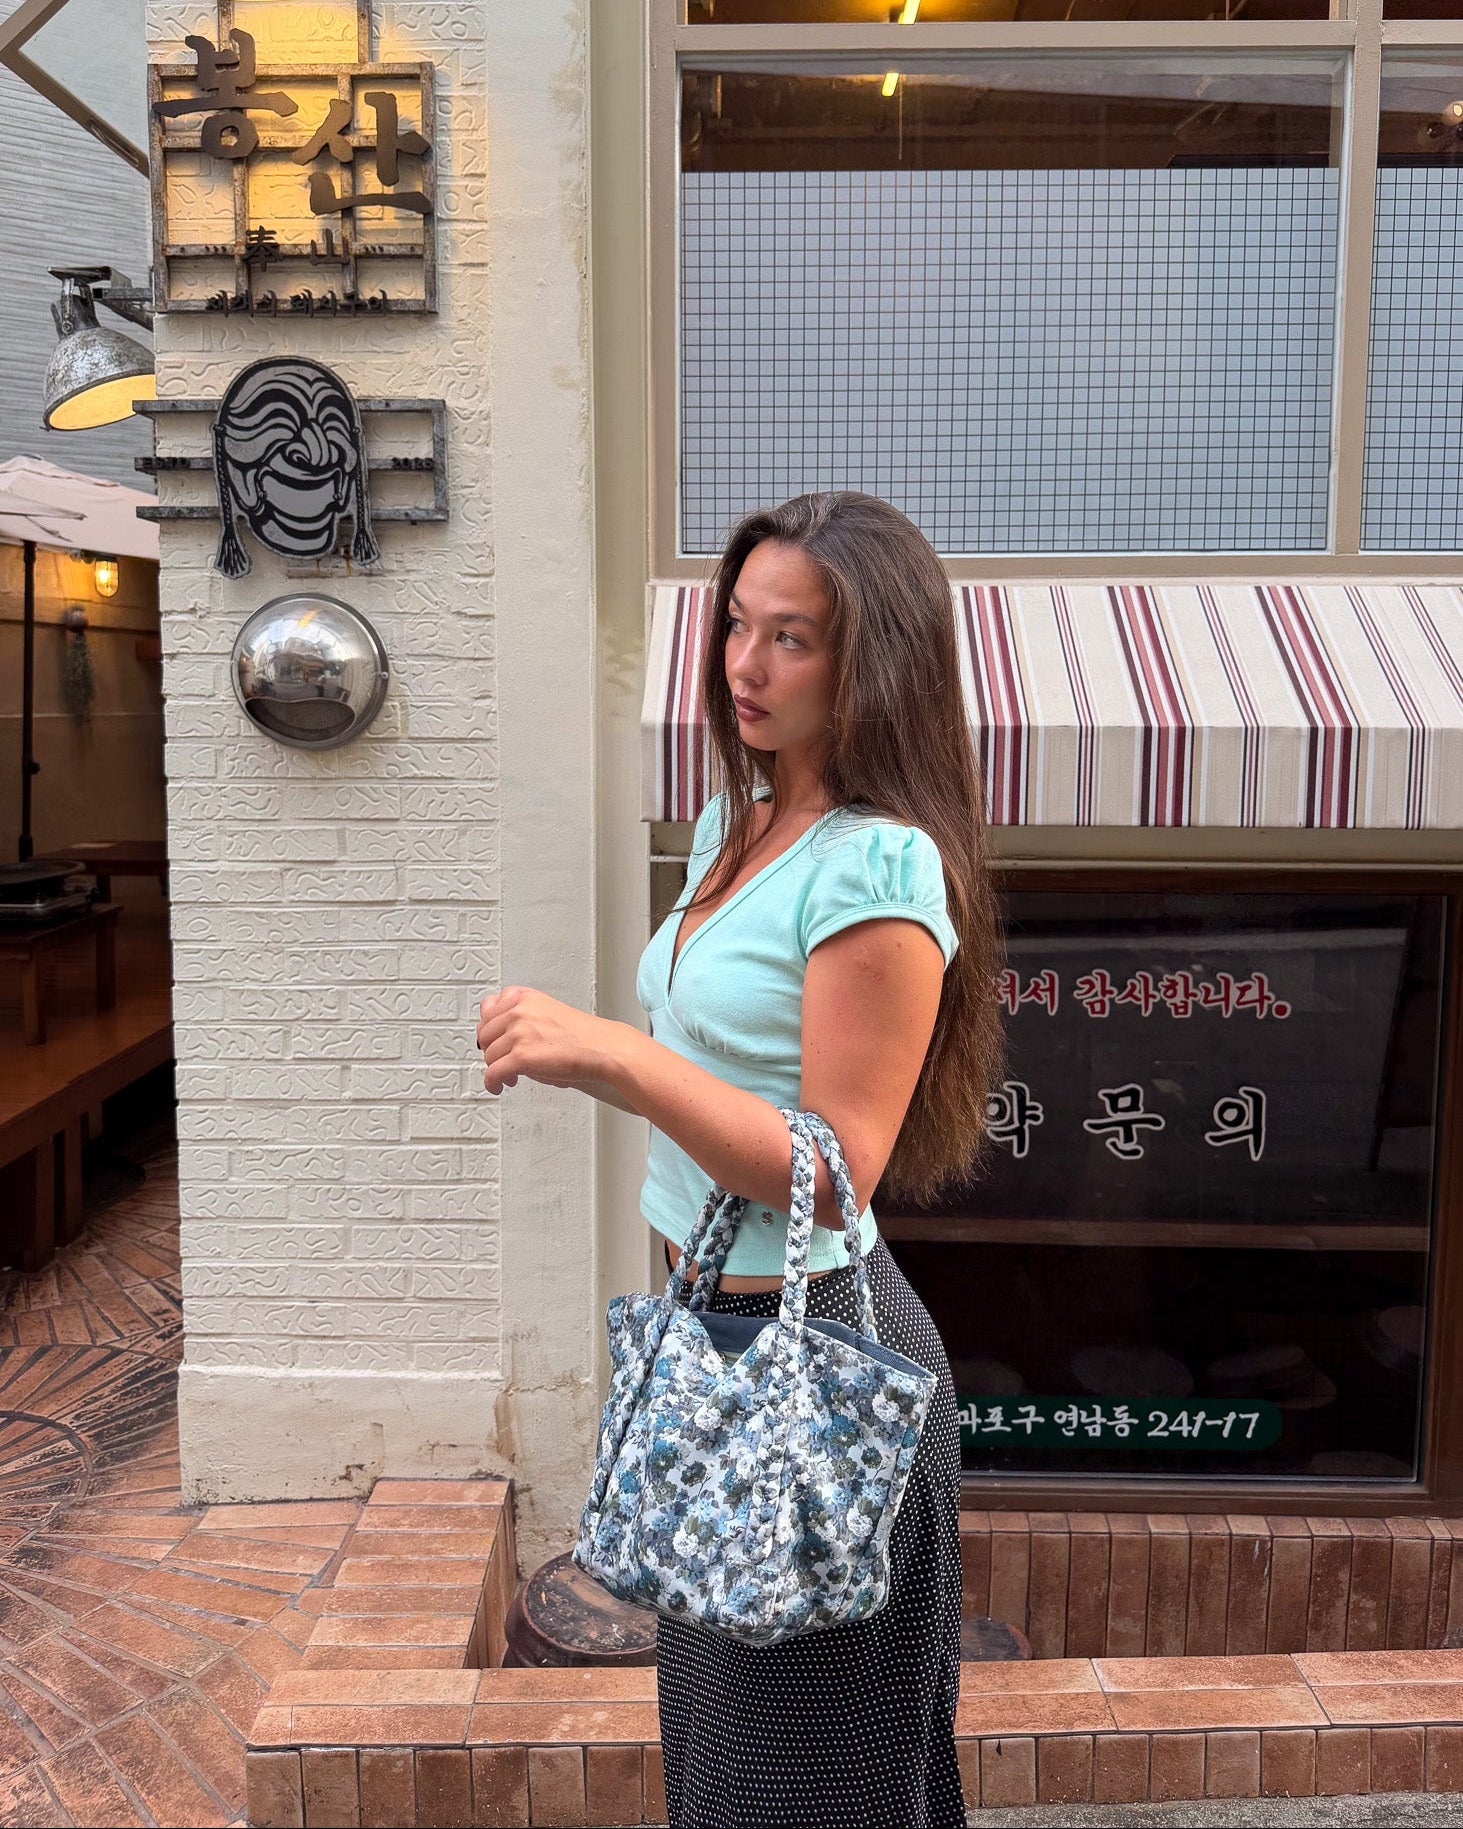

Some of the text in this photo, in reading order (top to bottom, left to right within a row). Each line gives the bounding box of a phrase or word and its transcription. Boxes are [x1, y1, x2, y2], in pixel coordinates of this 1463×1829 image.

[151, 27, 433, 216] 봉산
[1072, 969, 1292, 1019] 감사합니다.
[957, 1403, 1261, 1440] 마포구 연남동 241-17
